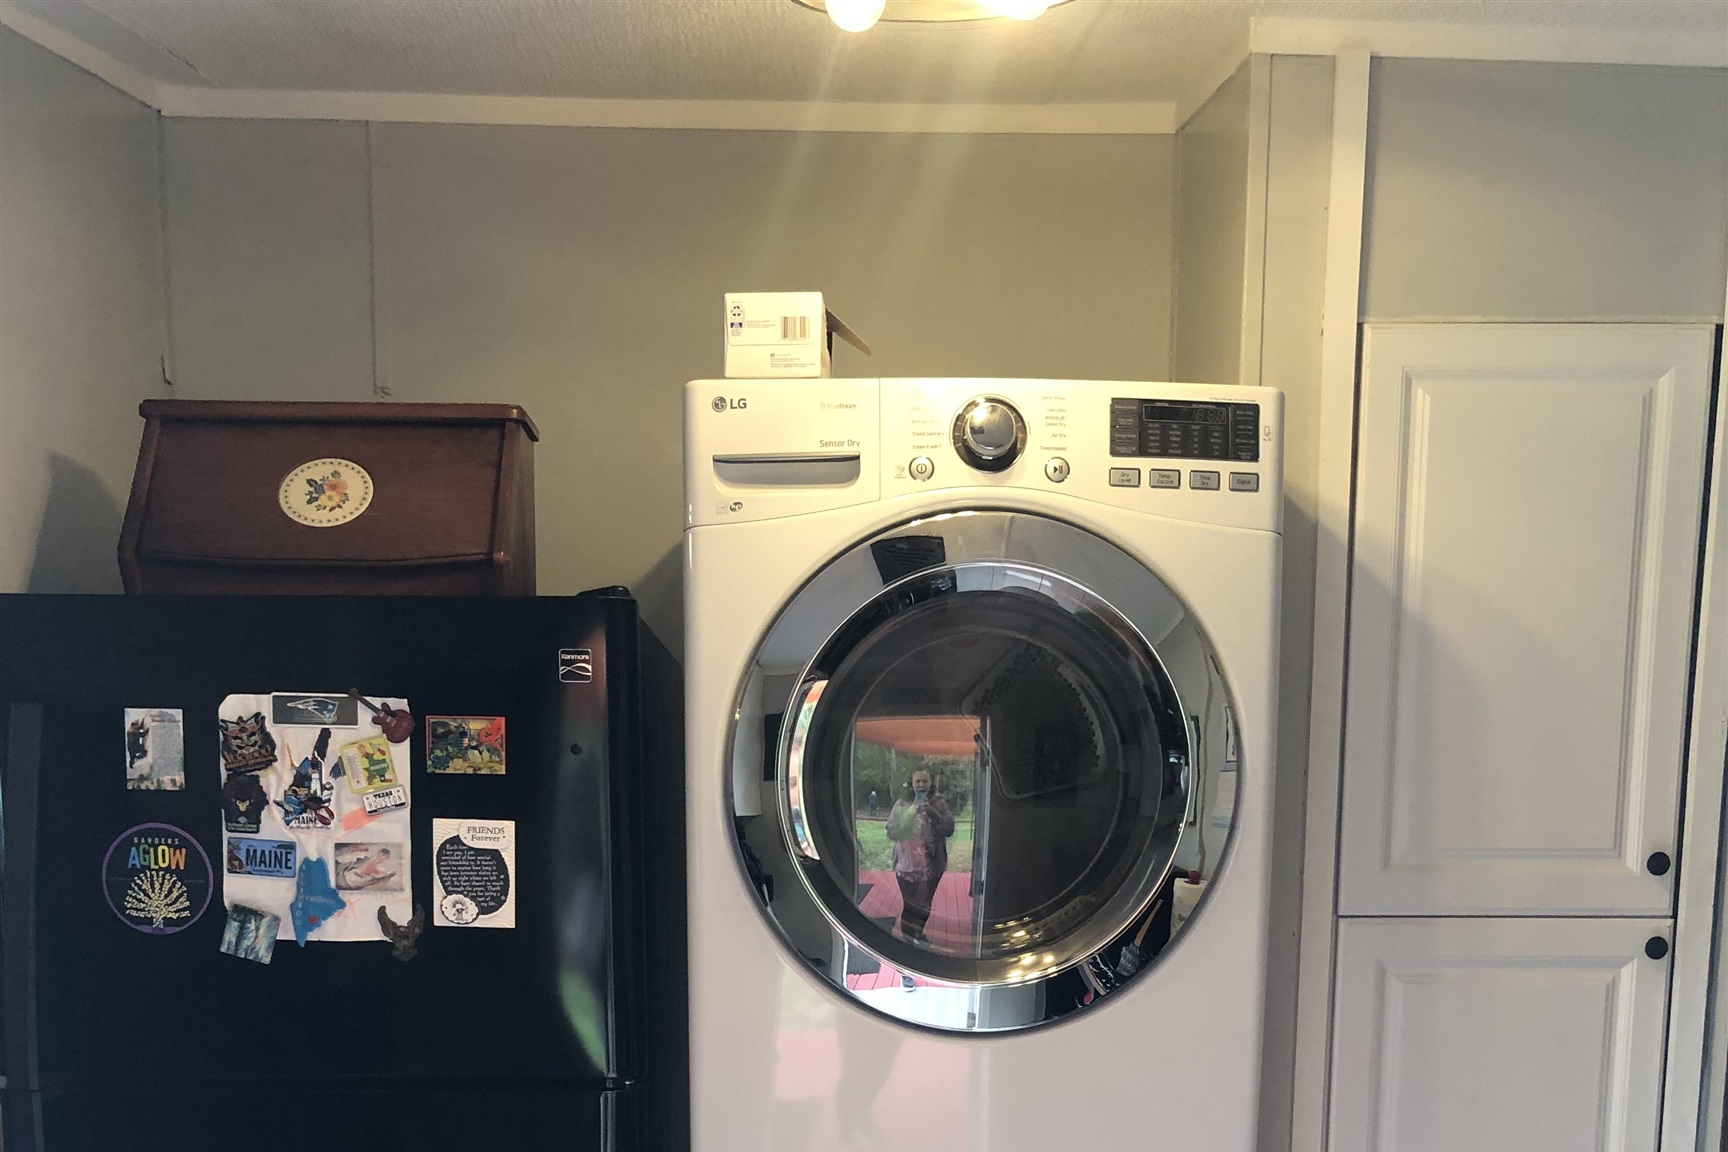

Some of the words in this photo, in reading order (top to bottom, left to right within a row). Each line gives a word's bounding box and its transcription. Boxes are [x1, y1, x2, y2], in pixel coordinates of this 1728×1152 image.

[730, 398, 747, 409] LG
[847, 440, 860, 448] Dry
[373, 791, 393, 799] TEXAS
[368, 794, 402, 809] HOUSTON
[467, 827, 505, 835] FRIENDS
[134, 837, 179, 845] GARDENS
[128, 844, 187, 870] AGLOW
[246, 848, 293, 870] MAINE
